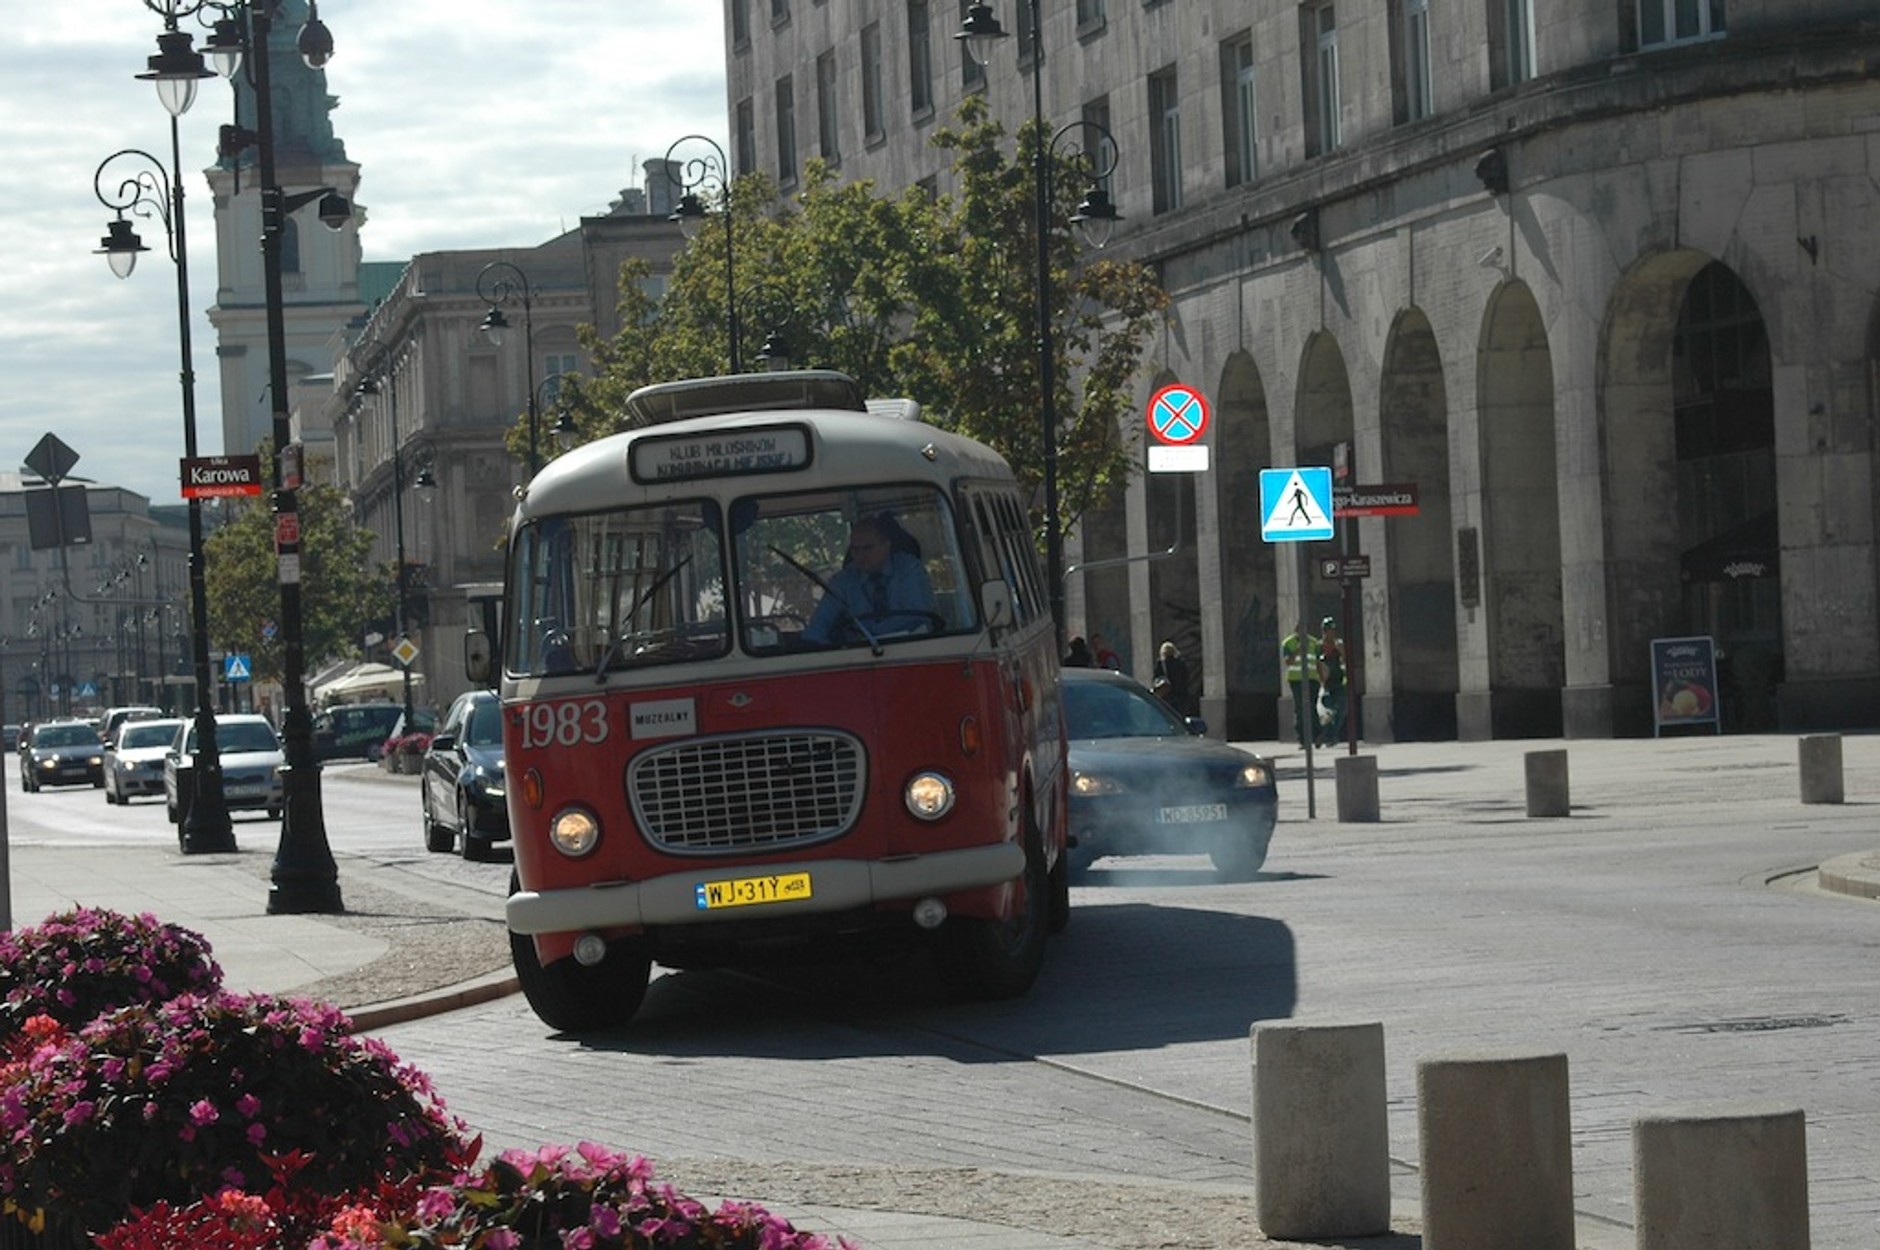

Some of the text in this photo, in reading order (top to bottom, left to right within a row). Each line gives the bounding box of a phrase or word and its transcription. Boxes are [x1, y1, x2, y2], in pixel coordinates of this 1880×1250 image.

[191, 467, 250, 483] Karowa
[1326, 563, 1336, 575] P
[522, 700, 609, 749] 1983
[635, 711, 689, 725] MUZEALNY
[708, 882, 735, 904] WJ
[745, 877, 779, 900] 31Y
